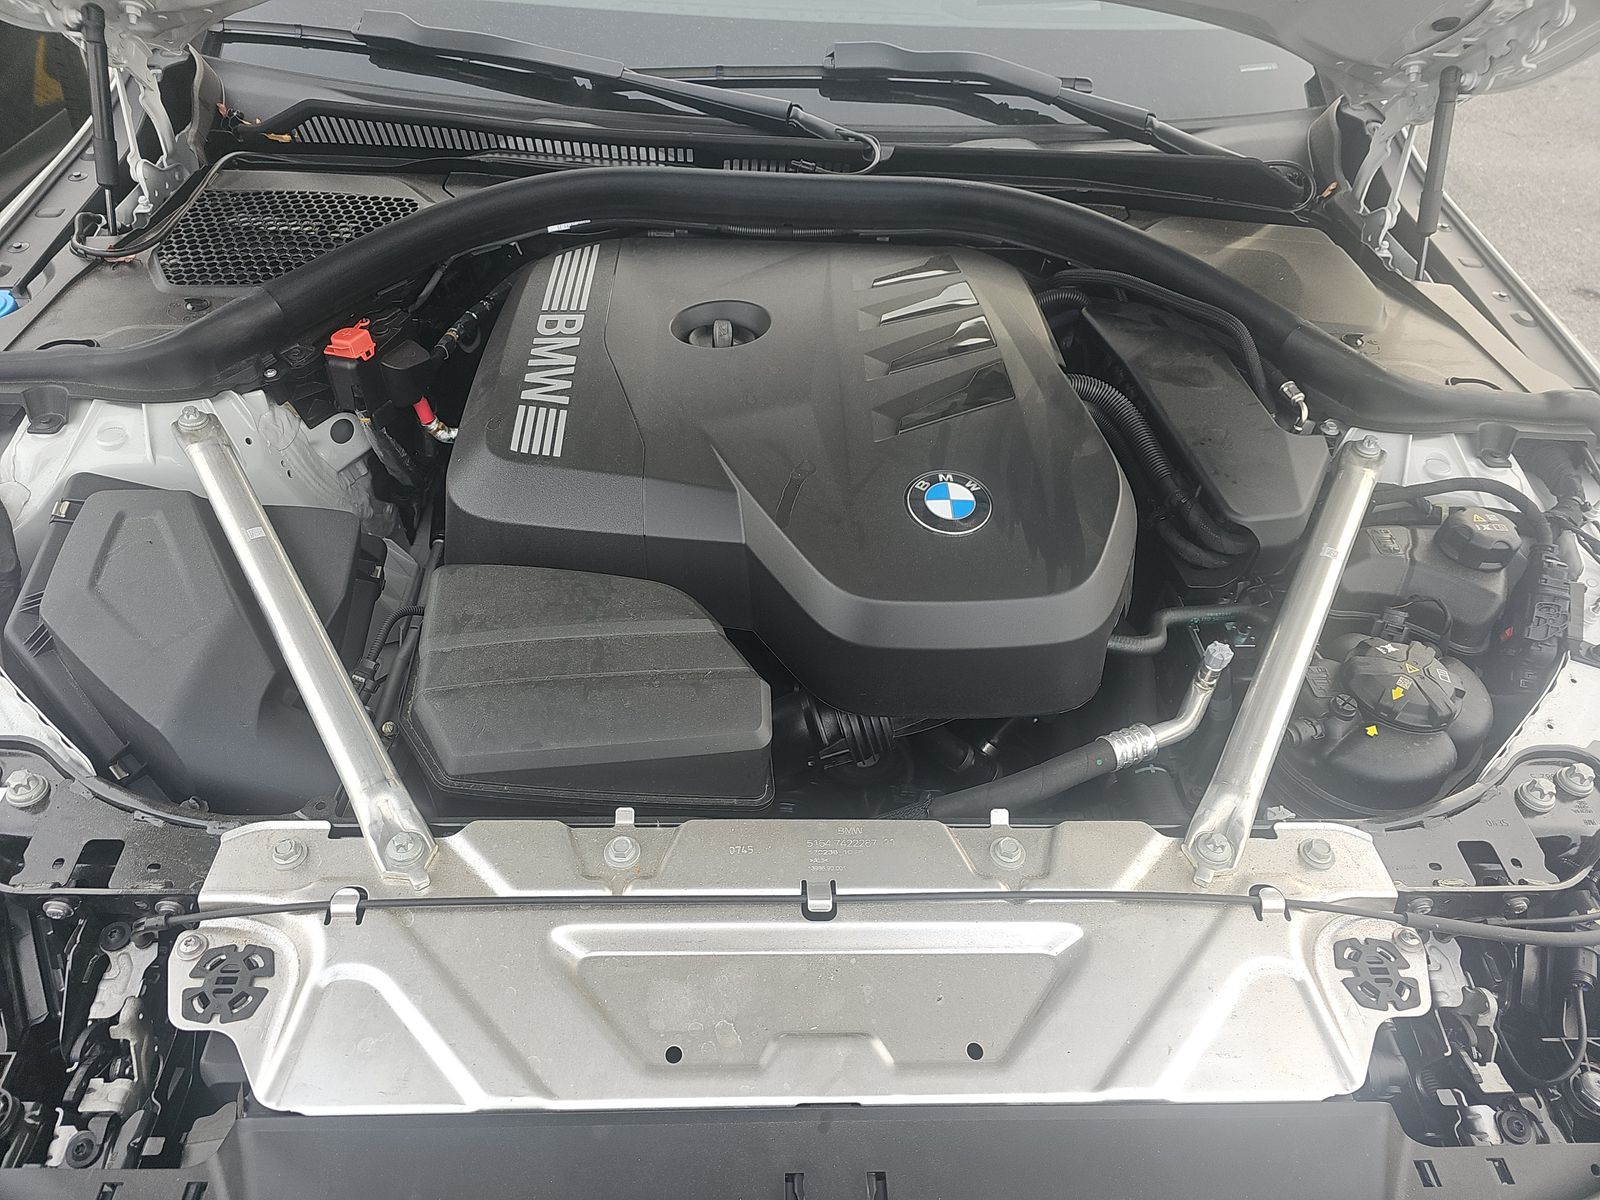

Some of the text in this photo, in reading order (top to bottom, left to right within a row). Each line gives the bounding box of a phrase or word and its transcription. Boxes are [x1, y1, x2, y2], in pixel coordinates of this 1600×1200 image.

[520, 314, 585, 404] BMW
[915, 474, 981, 492] BMW
[837, 827, 863, 835] BMW
